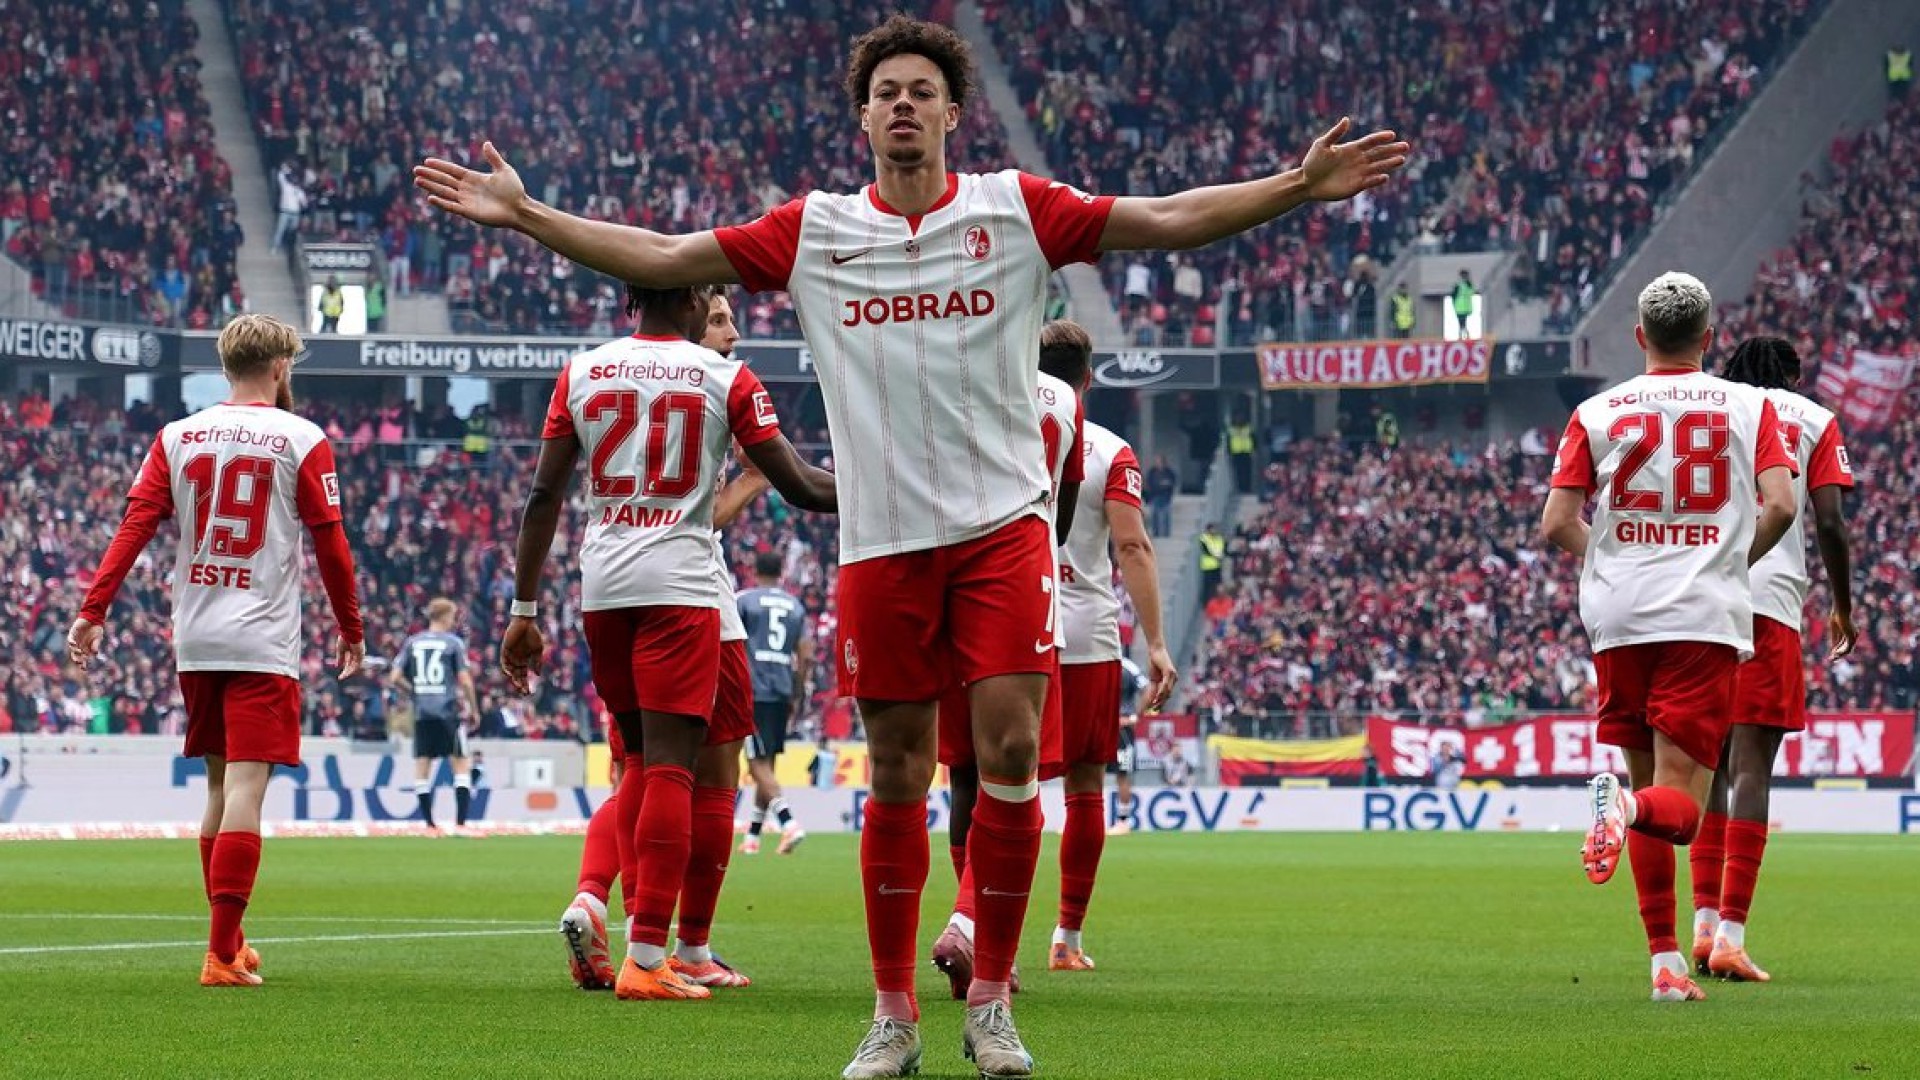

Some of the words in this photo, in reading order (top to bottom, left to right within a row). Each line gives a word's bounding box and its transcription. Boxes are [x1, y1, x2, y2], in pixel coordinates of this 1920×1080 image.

[842, 289, 996, 327] JOBRAD
[359, 341, 471, 372] Freiburg
[1263, 341, 1488, 383] MUCHACHOS
[583, 390, 707, 499] 20
[1607, 410, 1731, 514] 28
[184, 453, 276, 559] 19
[600, 503, 682, 528] AAMU
[1616, 522, 1720, 546] GINTER
[768, 607, 789, 651] 5
[413, 649, 445, 684] 16
[1109, 791, 1230, 831] BGV
[1365, 791, 1490, 831] BGV
